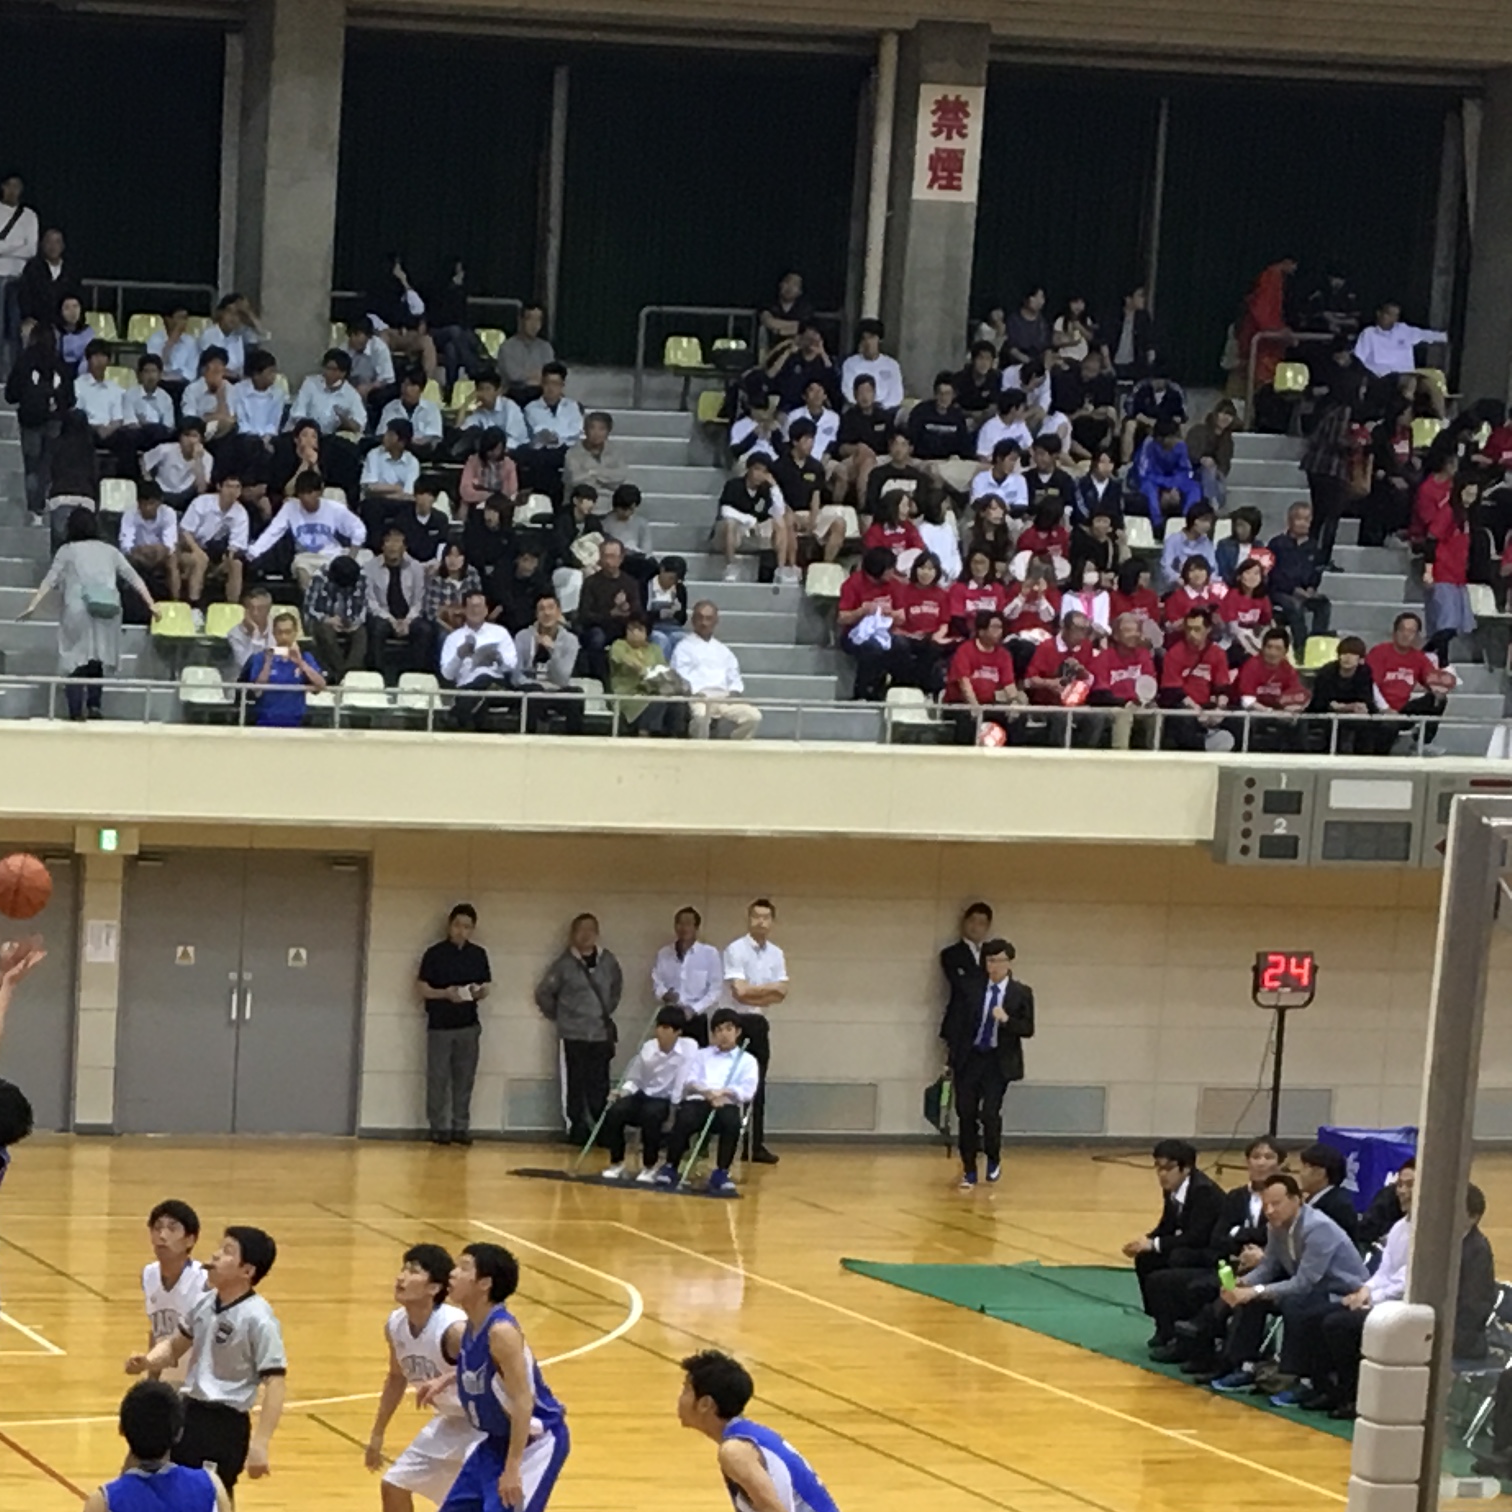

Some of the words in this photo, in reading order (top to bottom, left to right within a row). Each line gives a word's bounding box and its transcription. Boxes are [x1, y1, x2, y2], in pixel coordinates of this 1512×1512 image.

[927, 94, 970, 192] 禁煙
[1279, 772, 1287, 790] 1
[1272, 817, 1288, 835] 2
[1263, 954, 1311, 988] 24
